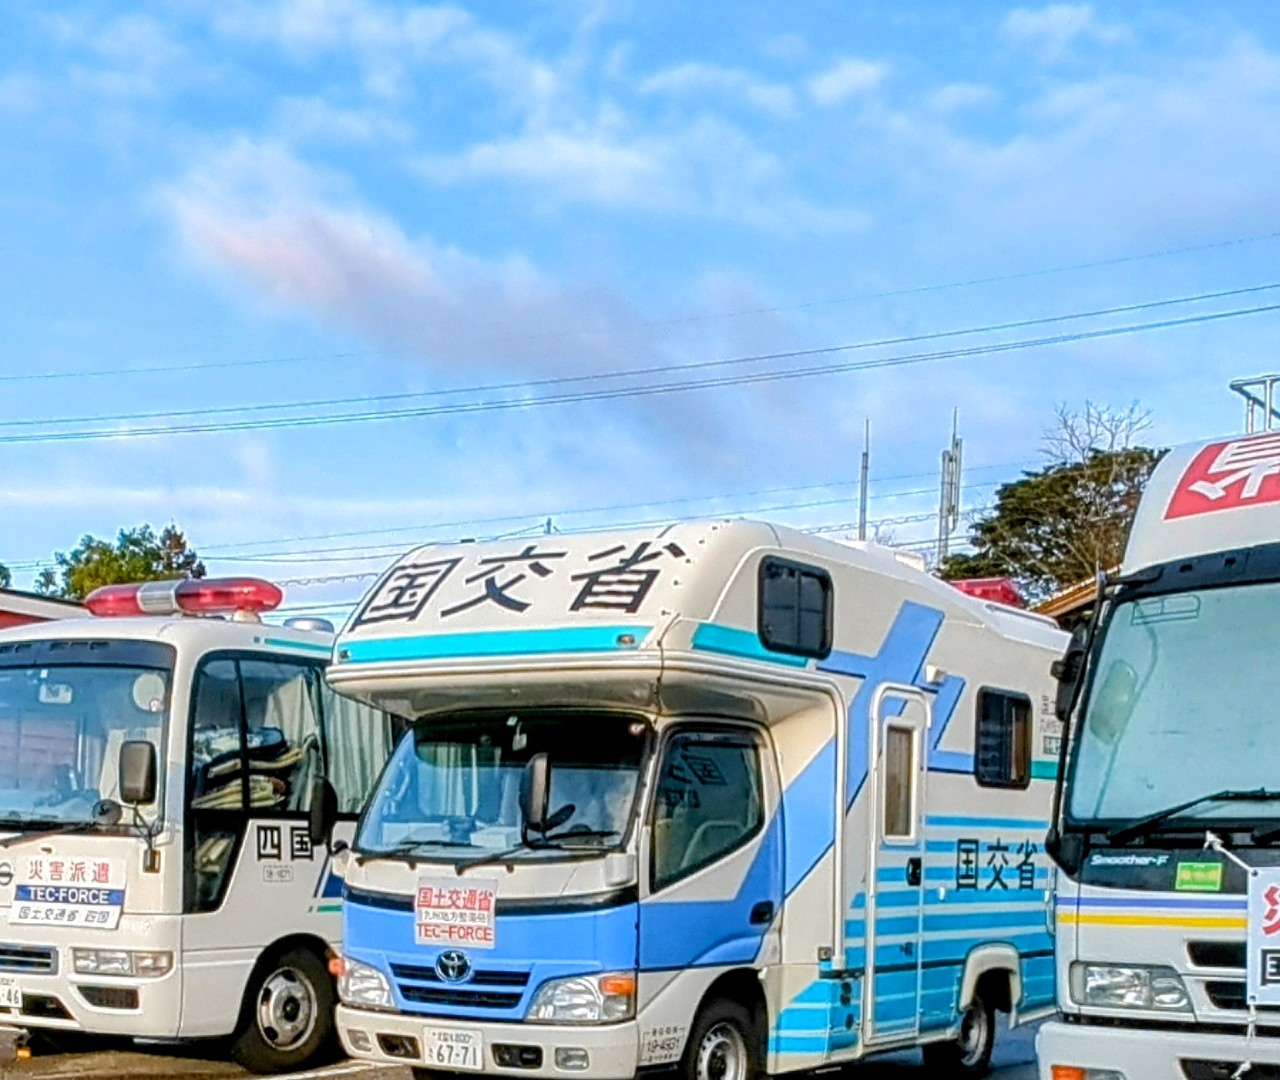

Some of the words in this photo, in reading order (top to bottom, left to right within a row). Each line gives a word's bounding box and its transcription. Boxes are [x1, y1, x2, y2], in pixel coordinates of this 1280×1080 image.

[347, 541, 686, 633] 国交省
[257, 826, 314, 861] 四国
[29, 860, 110, 884] 災害派遣
[956, 836, 1039, 891] 国交省
[28, 886, 110, 904] TEC-FORCE
[418, 887, 494, 911] 国土交通省
[417, 923, 493, 942] TEC-FORCE
